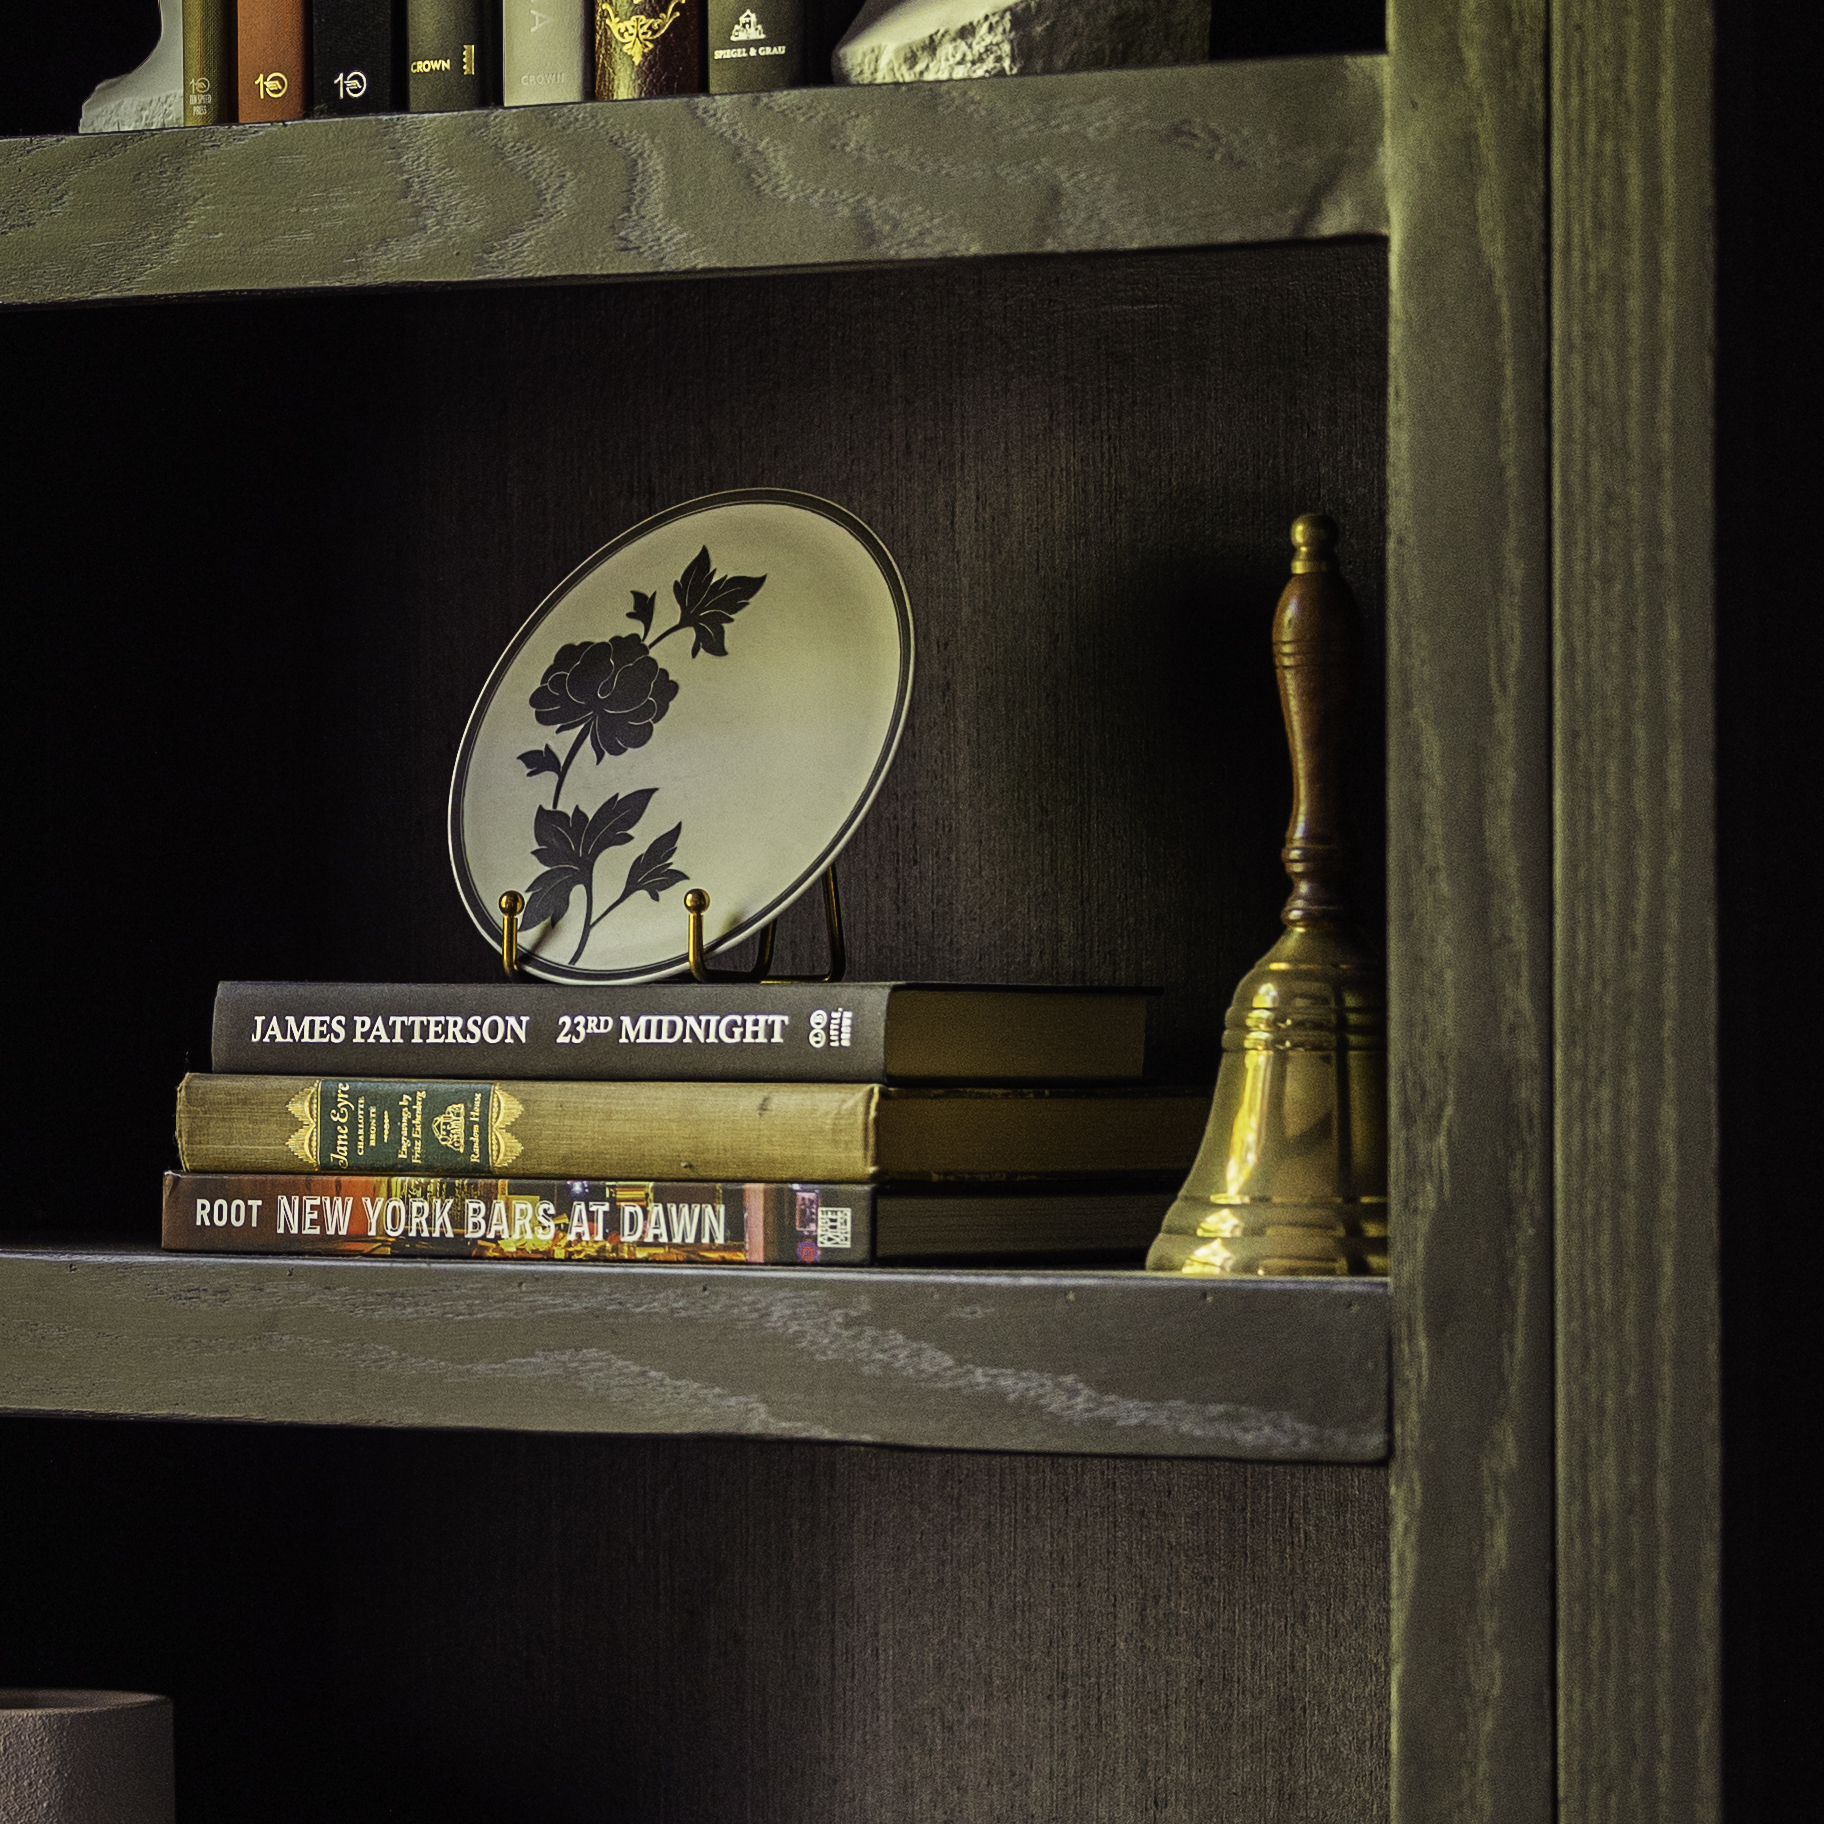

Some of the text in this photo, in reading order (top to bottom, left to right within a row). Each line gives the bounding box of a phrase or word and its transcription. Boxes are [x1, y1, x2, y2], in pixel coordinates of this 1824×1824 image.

[410, 58, 451, 74] CROWN
[714, 48, 748, 60] SPIEGEL
[758, 45, 786, 56] GRAU
[520, 72, 566, 86] CROWN
[251, 1014, 789, 1044] JAMES PATTERSON 23RD MIDNIGHT
[829, 1007, 842, 1047] LITTLE,
[329, 1082, 355, 1169] Jane Eyre
[357, 1095, 365, 1156] CHARLOTTE
[398, 1093, 412, 1159] Engravings by
[470, 1092, 481, 1163] Random House
[195, 1195, 726, 1244] ROOT NEW YORK BARS AT DAWN
